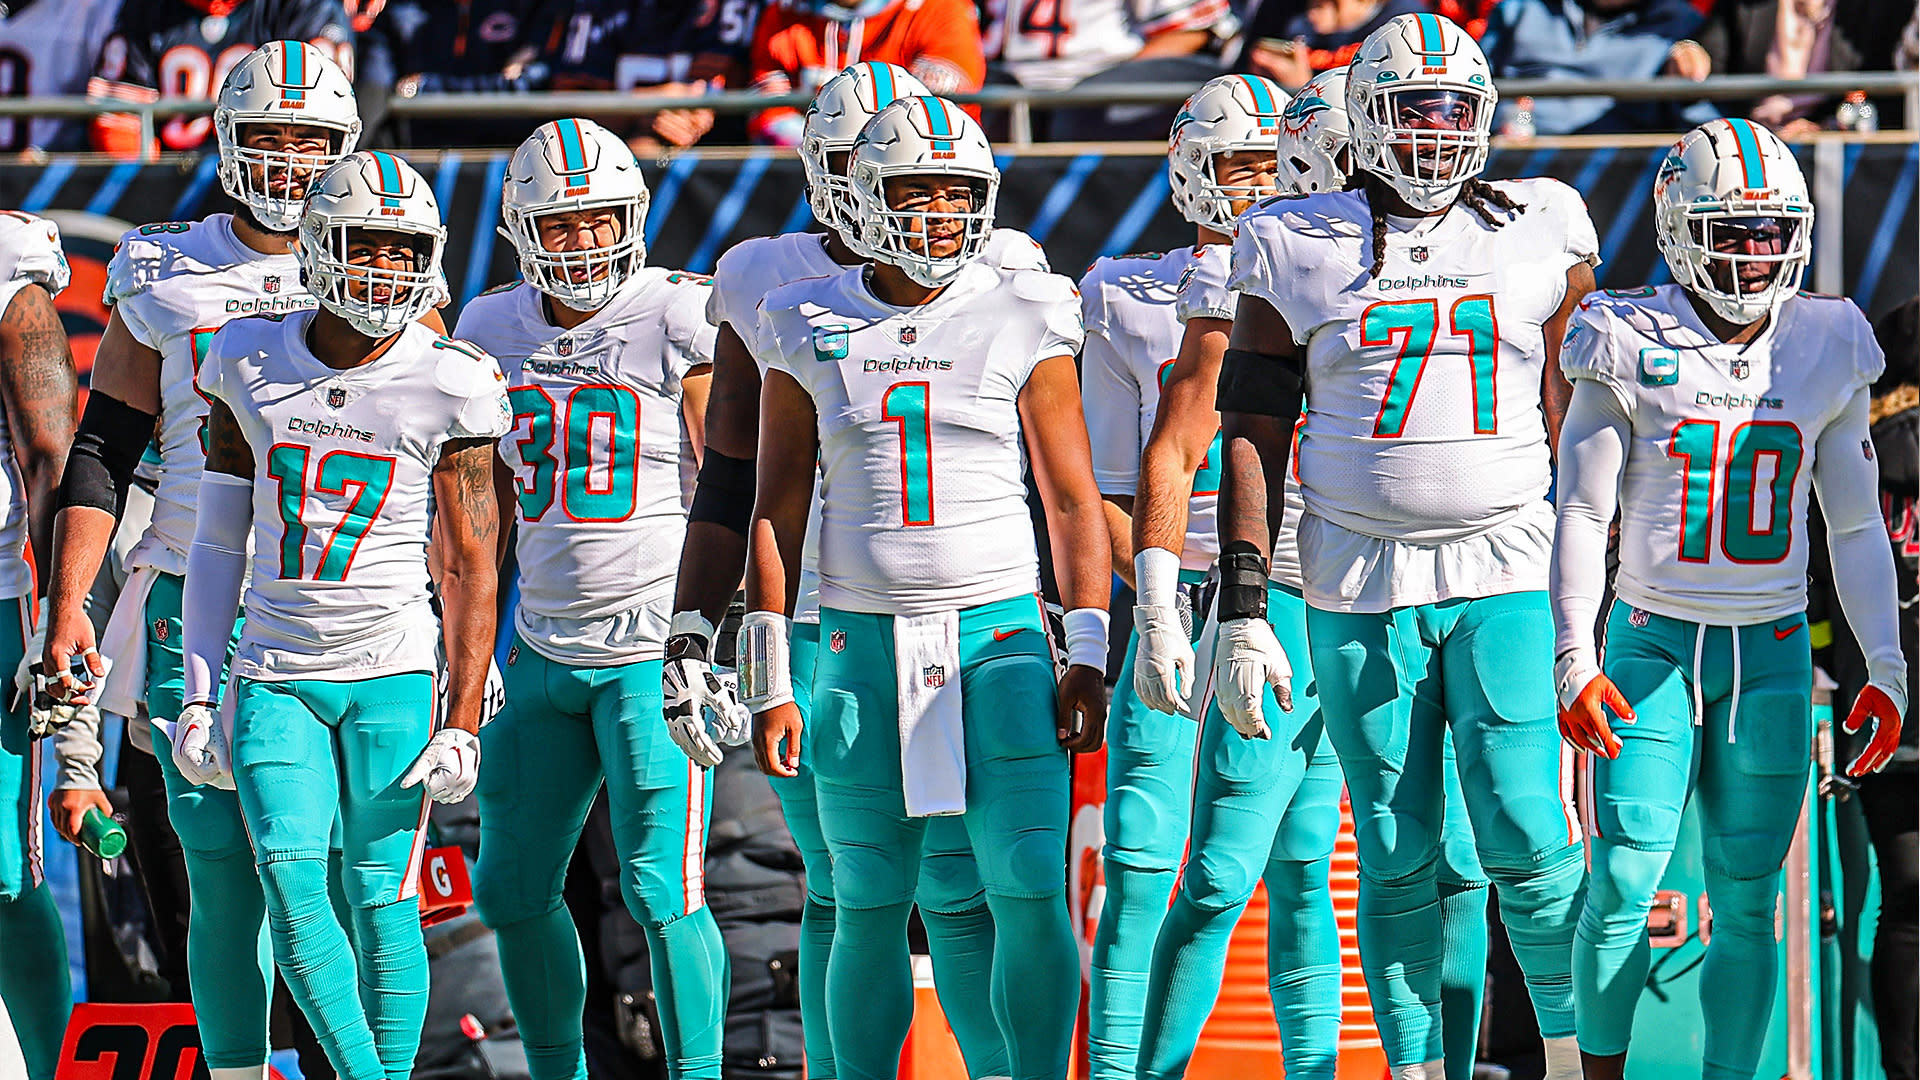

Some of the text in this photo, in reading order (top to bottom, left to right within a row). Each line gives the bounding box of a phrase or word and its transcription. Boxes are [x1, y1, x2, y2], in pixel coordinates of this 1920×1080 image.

[1378, 274, 1469, 291] Dolphins
[224, 296, 317, 313] Dolphins
[520, 358, 599, 377] Dolphins
[863, 356, 953, 374] Dolphins
[1360, 294, 1499, 438] 71
[1695, 390, 1784, 410] Dolphins
[287, 416, 376, 442] Dolphins
[507, 384, 641, 523] 30
[881, 381, 934, 526] 1
[1668, 418, 1804, 564] 10
[267, 442, 397, 581] 17
[430, 856, 453, 897] G
